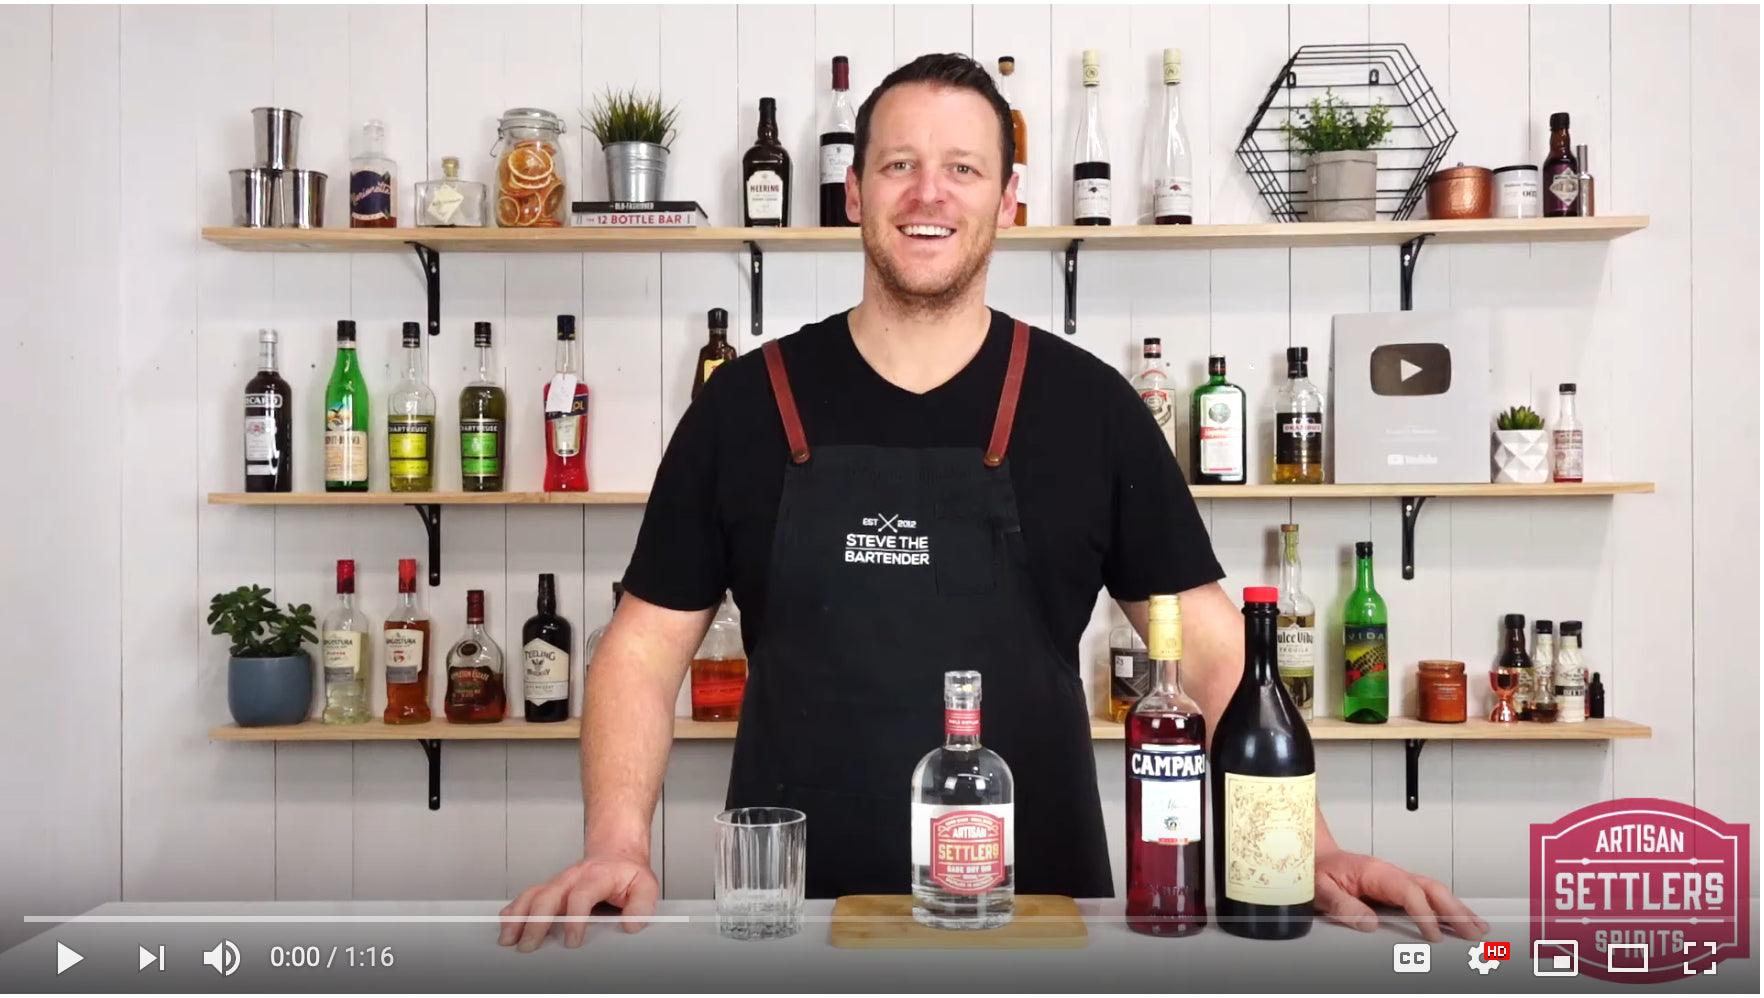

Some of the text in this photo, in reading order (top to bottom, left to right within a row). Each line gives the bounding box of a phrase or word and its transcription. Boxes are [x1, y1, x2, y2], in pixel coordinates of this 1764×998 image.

[597, 215, 608, 225] 12
[610, 215, 654, 225] BOTTLE
[658, 215, 682, 225] BAR
[862, 518, 917, 528] EST 2012
[846, 533, 929, 549] STEVE THE
[845, 550, 930, 565] BARTENDER
[1277, 631, 1296, 644] ulce
[1348, 631, 1386, 641] VIDA
[524, 650, 556, 661] TEELING
[952, 826, 988, 839] ARTISAN
[938, 843, 1000, 861] SETTLERS
